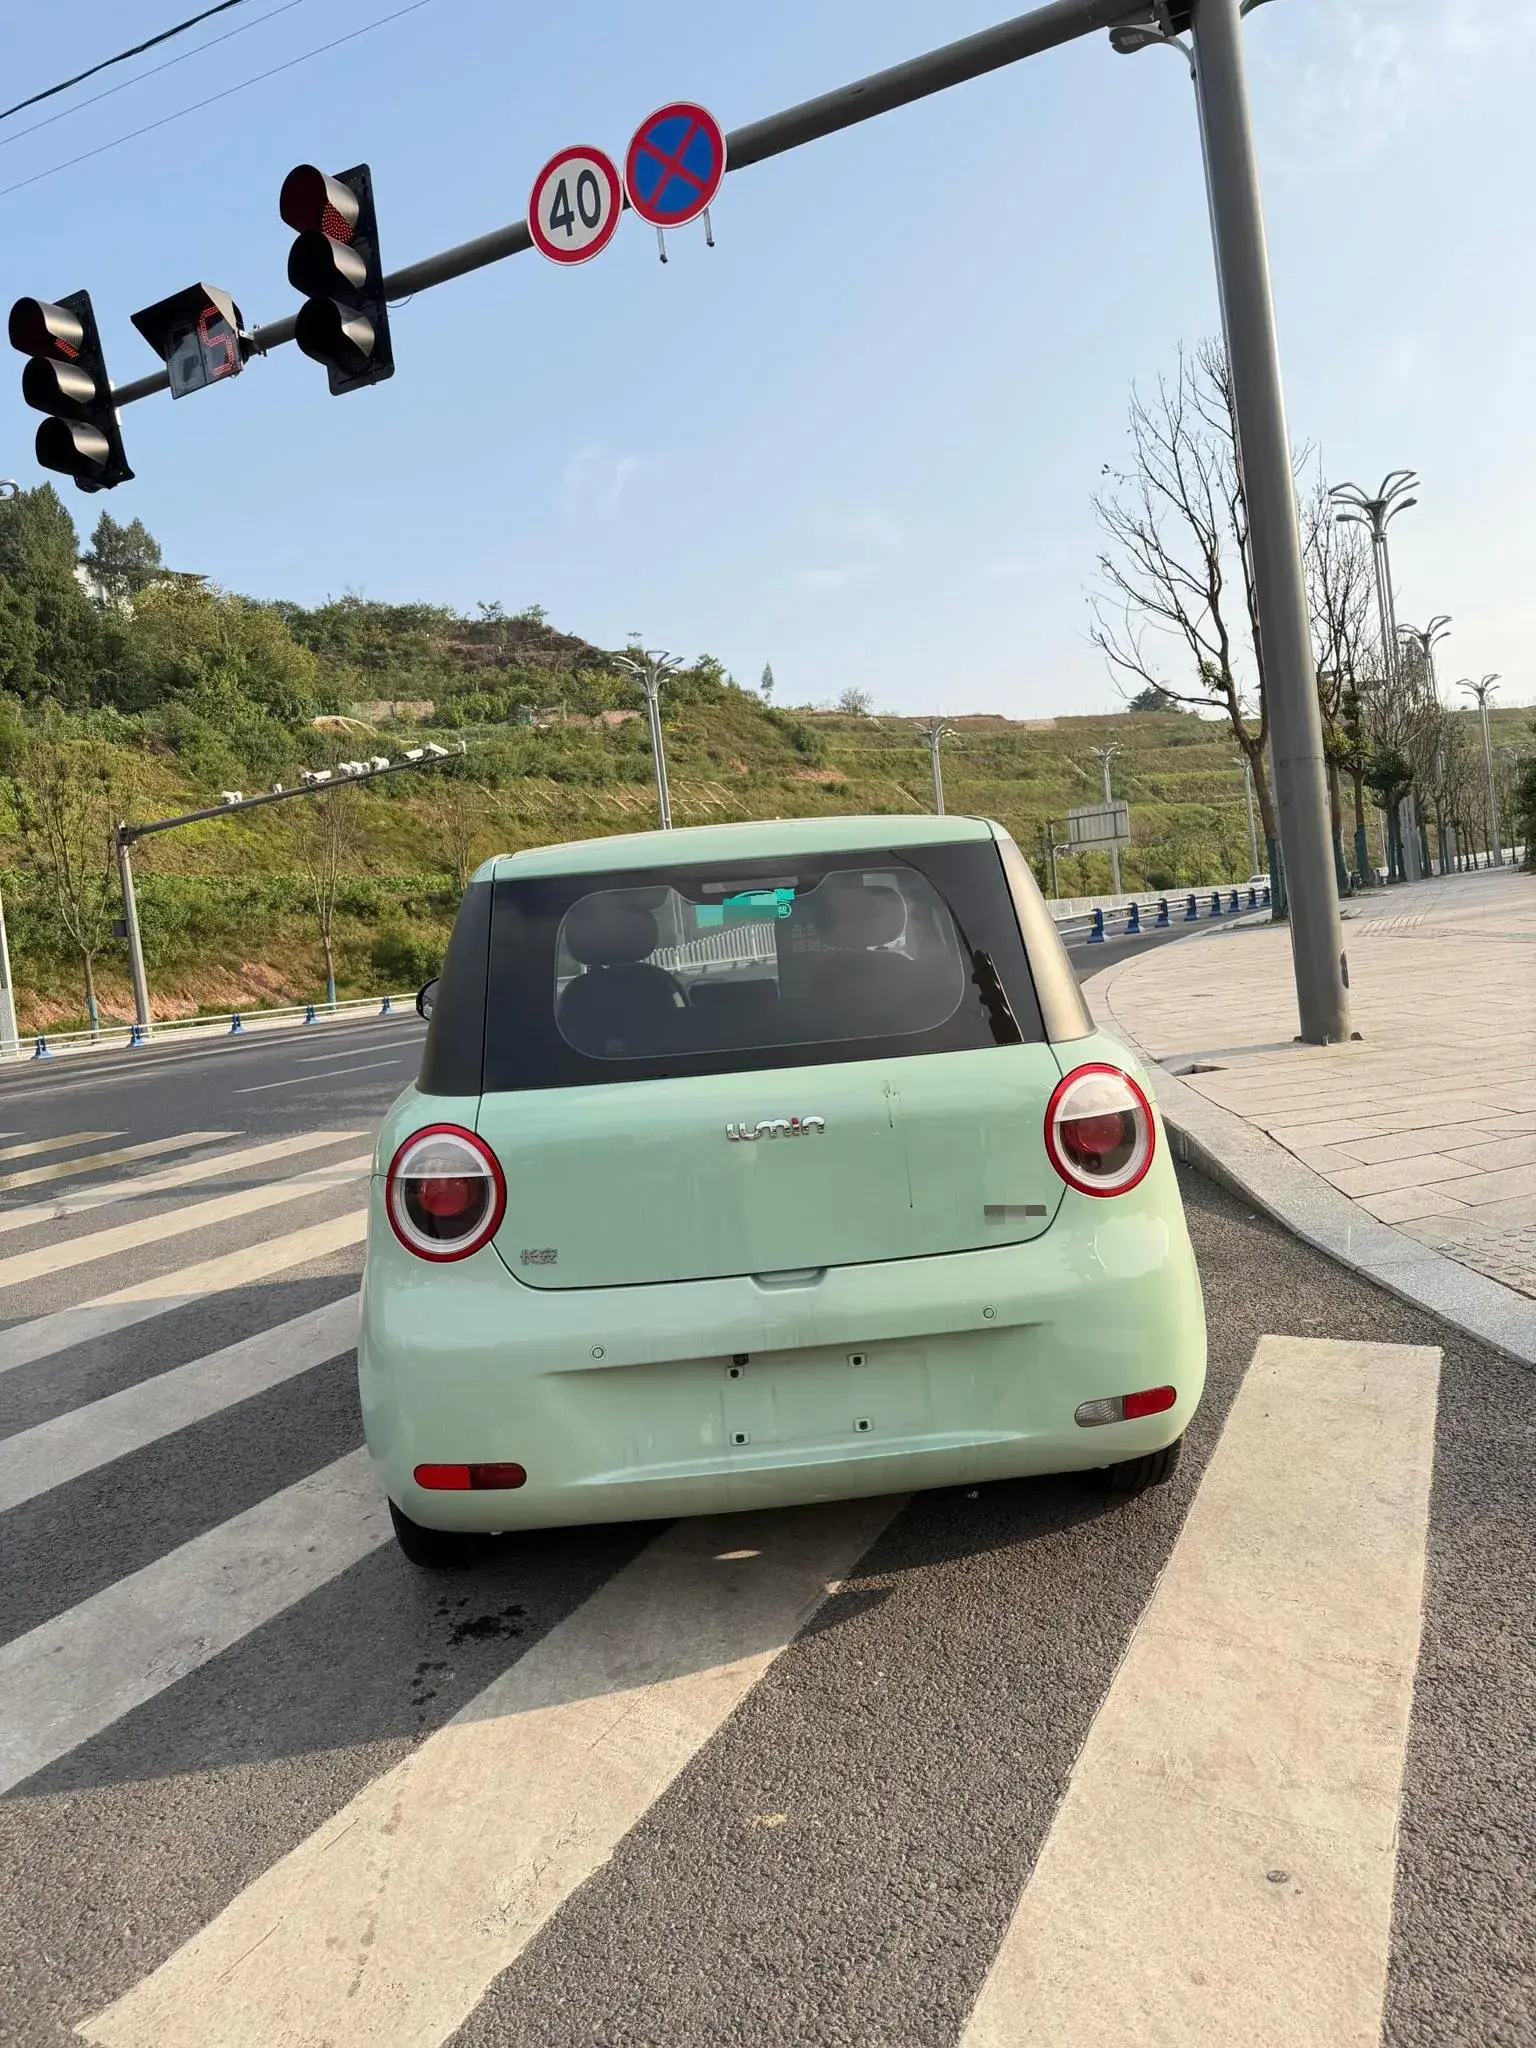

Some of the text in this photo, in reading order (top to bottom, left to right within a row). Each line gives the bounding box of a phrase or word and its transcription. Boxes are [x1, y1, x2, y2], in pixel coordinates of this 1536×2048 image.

[549, 169, 601, 237] 40
[199, 305, 236, 376] 5
[520, 1248, 557, 1266] 长安
